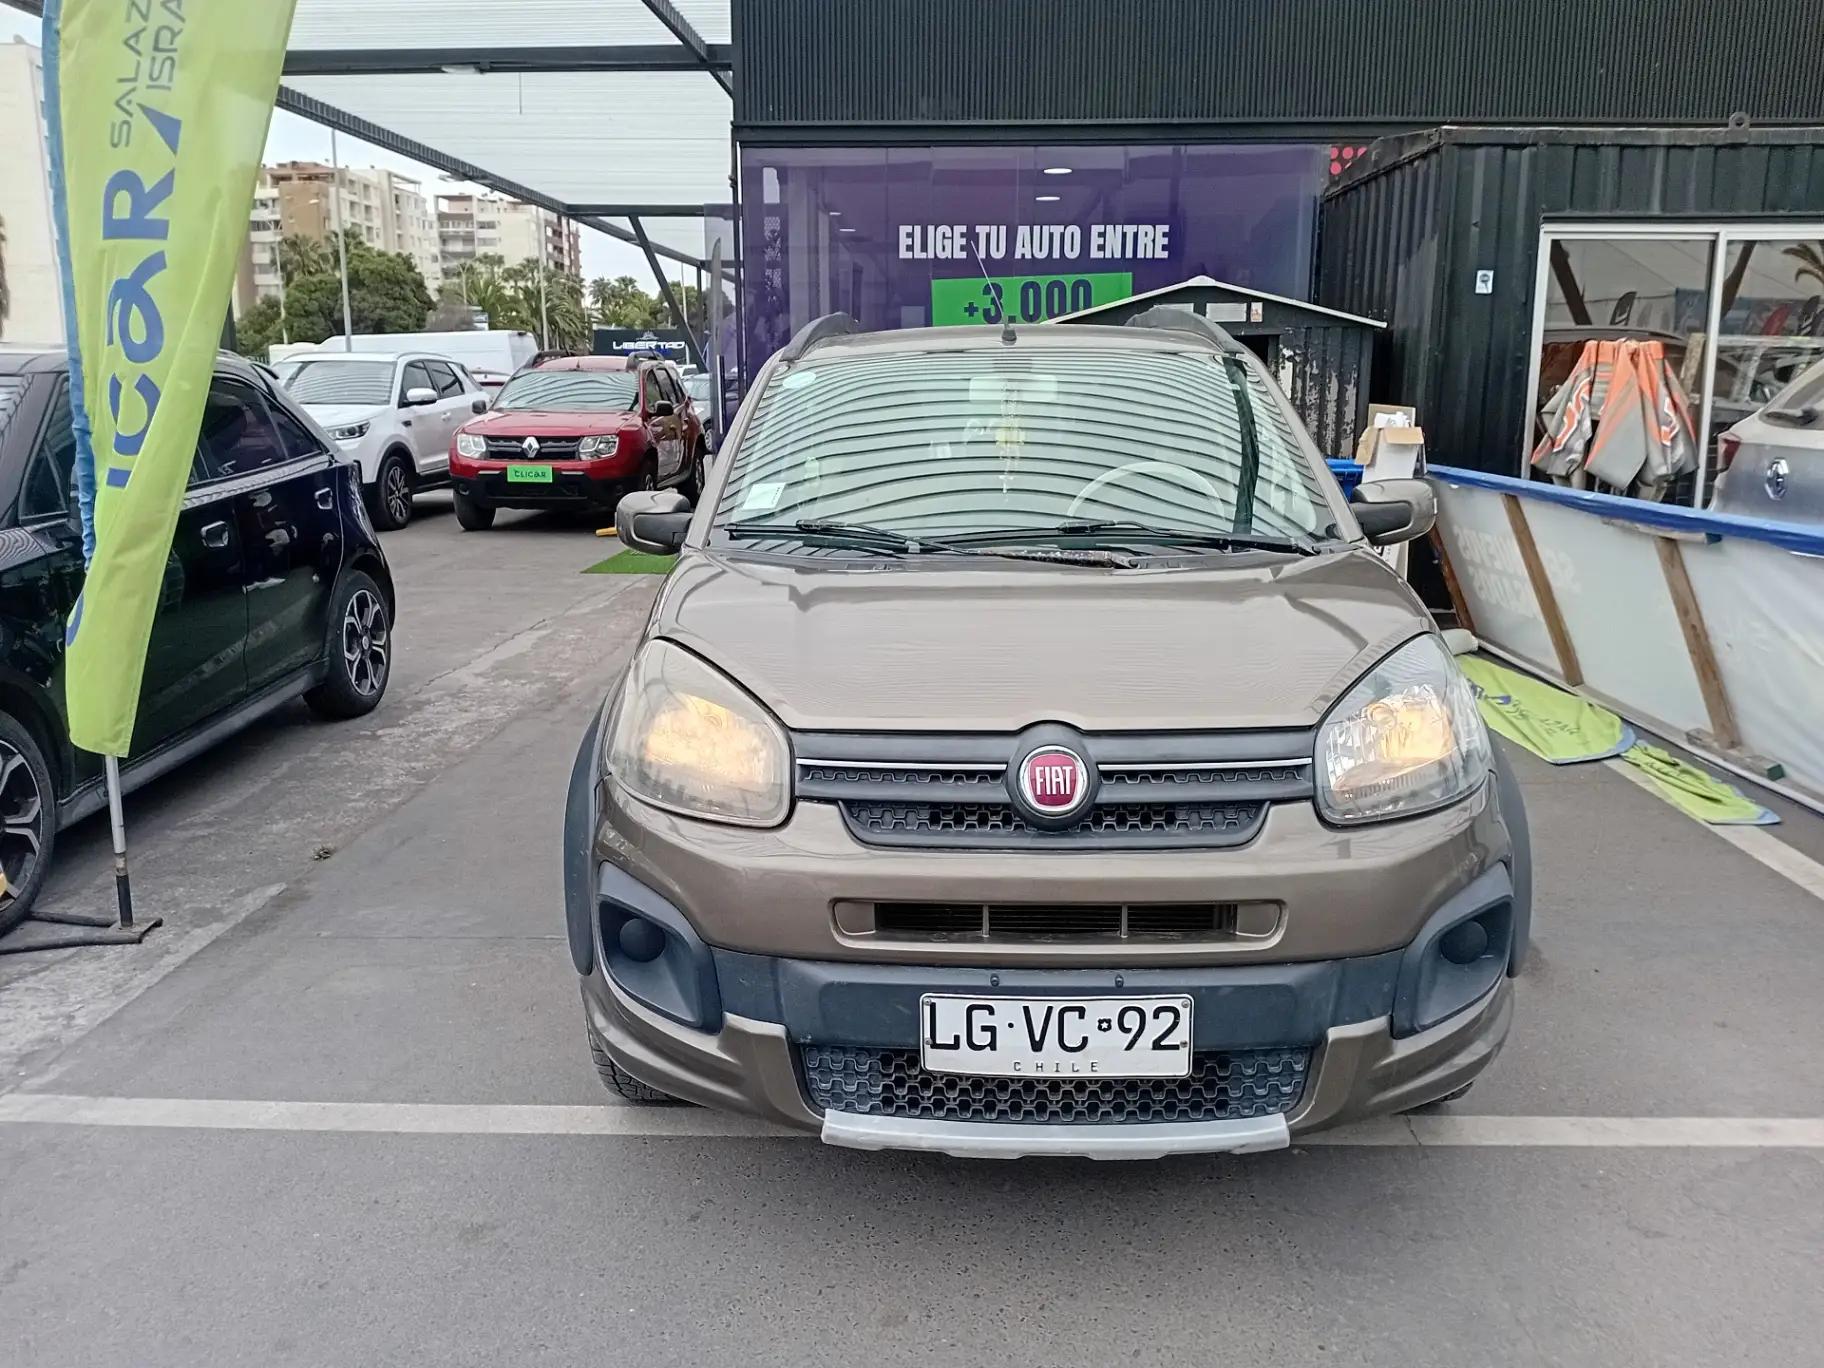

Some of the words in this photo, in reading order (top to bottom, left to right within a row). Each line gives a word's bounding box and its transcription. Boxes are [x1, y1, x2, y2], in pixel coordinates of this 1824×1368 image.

[898, 224, 968, 260] ELIGE
[975, 225, 1007, 260] TU
[1014, 224, 1082, 260] AUTO
[1089, 224, 1170, 259] ENTRE
[612, 340, 686, 350] LIBERTAD
[1035, 766, 1073, 795] FIAT
[1013, 1061, 1099, 1073] CHILE
